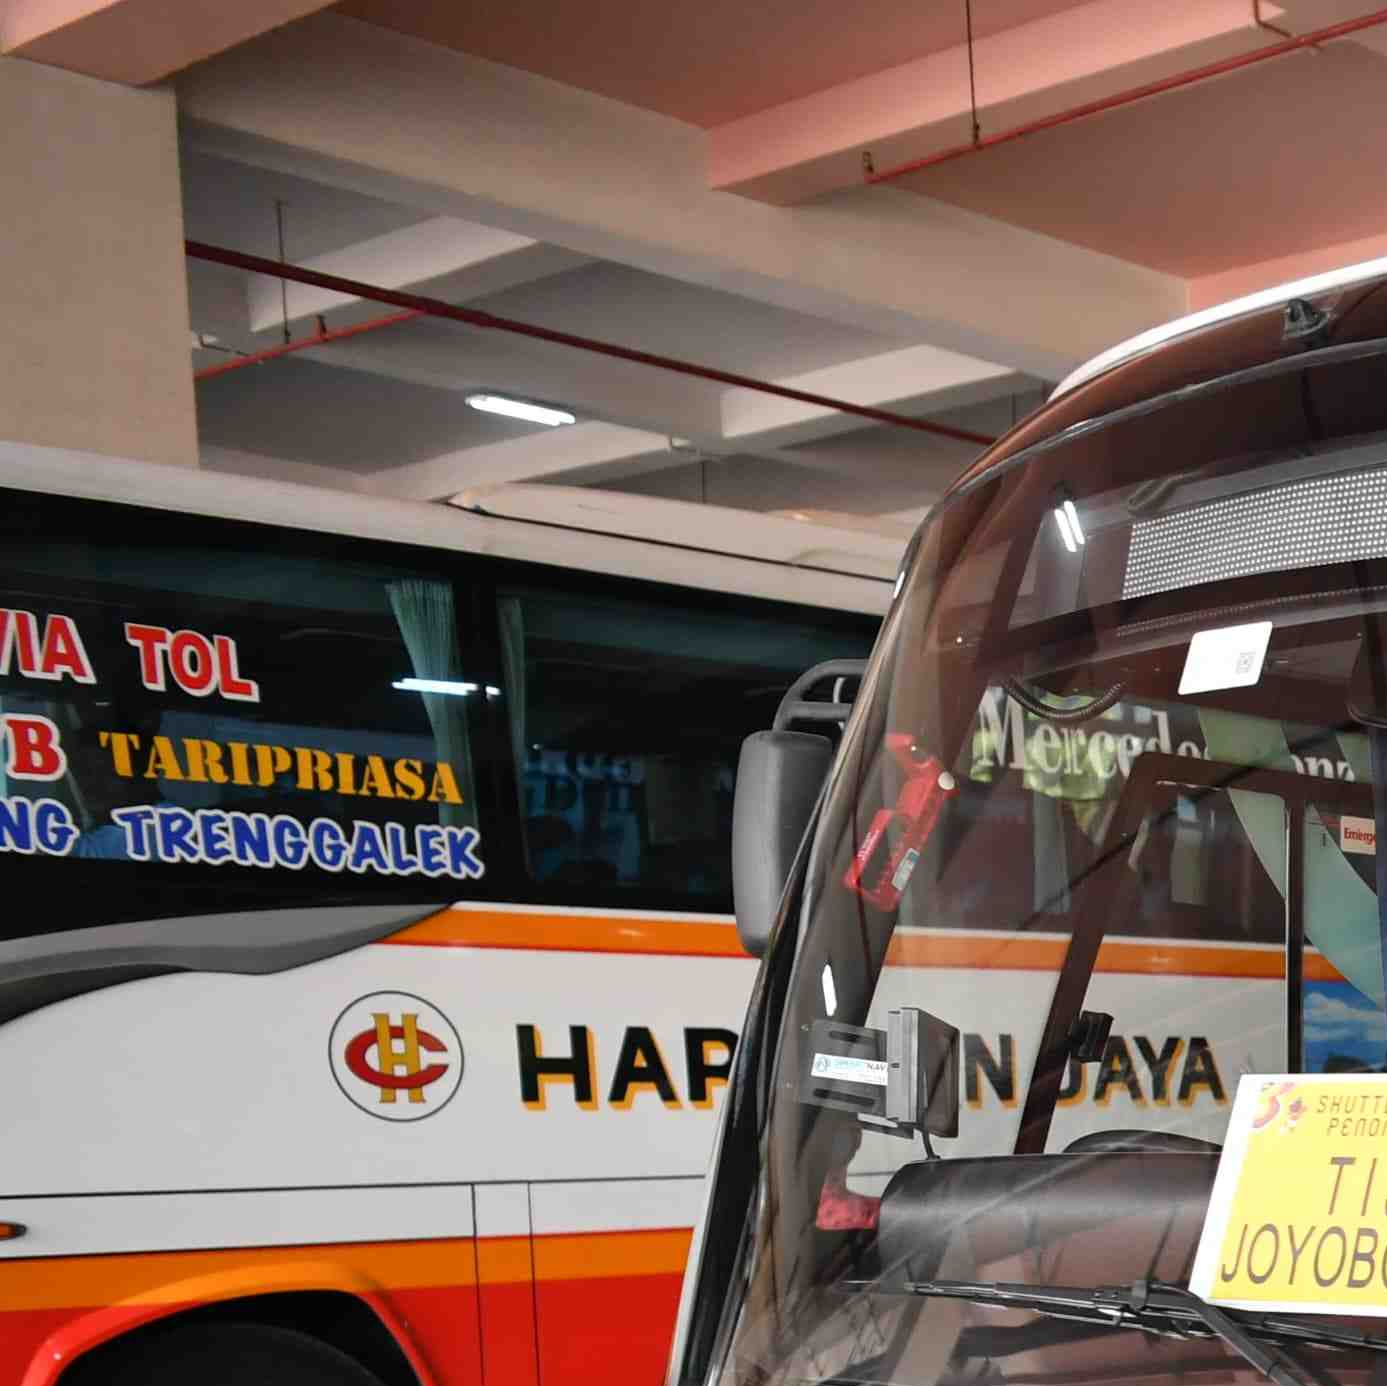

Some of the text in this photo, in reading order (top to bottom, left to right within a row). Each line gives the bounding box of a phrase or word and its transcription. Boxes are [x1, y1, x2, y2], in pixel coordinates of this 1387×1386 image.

[124, 622, 260, 703] TOL
[99, 730, 465, 804] TARIPBIASA
[111, 803, 486, 879] TRENGGALEK
